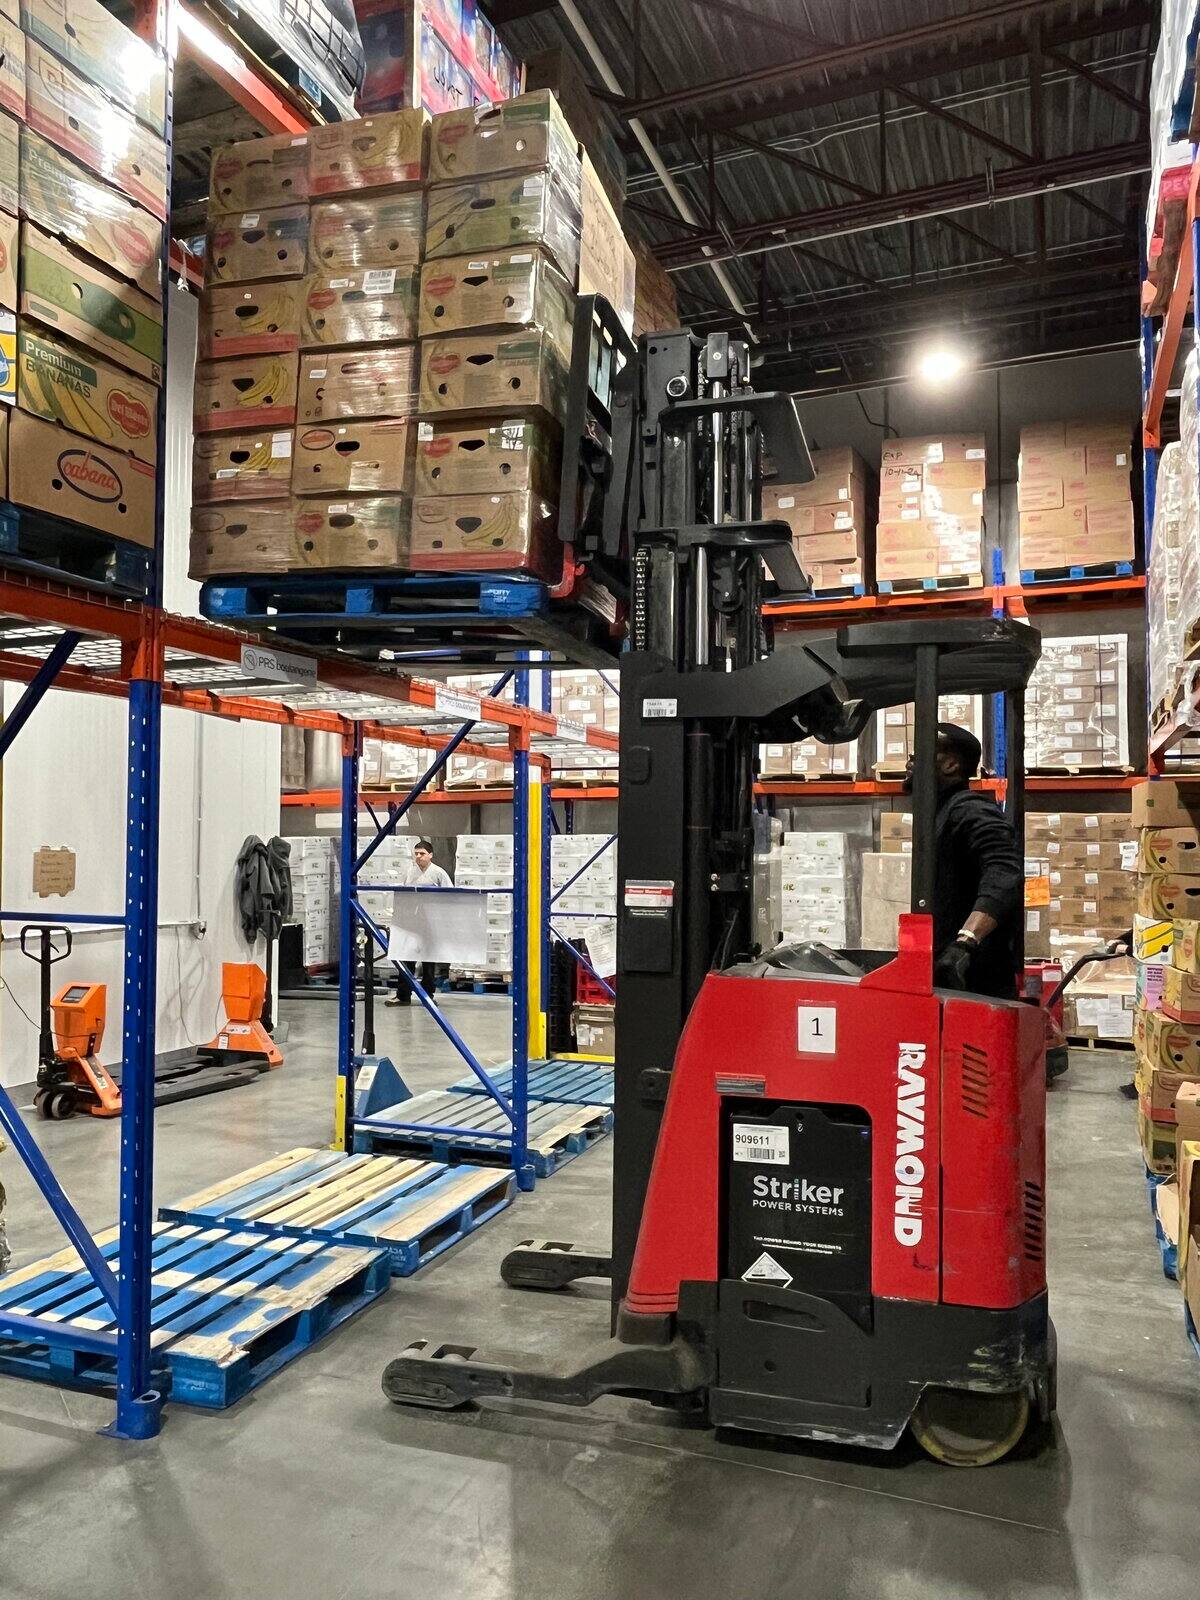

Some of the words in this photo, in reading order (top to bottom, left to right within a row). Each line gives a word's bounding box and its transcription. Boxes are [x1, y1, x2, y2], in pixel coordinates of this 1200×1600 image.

[25, 340, 82, 377] Premium
[26, 358, 91, 398] BANANAS
[63, 450, 116, 490] cabana
[258, 656, 275, 670] PRS
[811, 1017, 823, 1036] 1
[735, 1134, 769, 1145] 909611
[894, 1042, 927, 1247] RAYMOND
[753, 1175, 844, 1204] Striker
[752, 1199, 792, 1211] POWER
[795, 1204, 844, 1217] SYSTEMS
